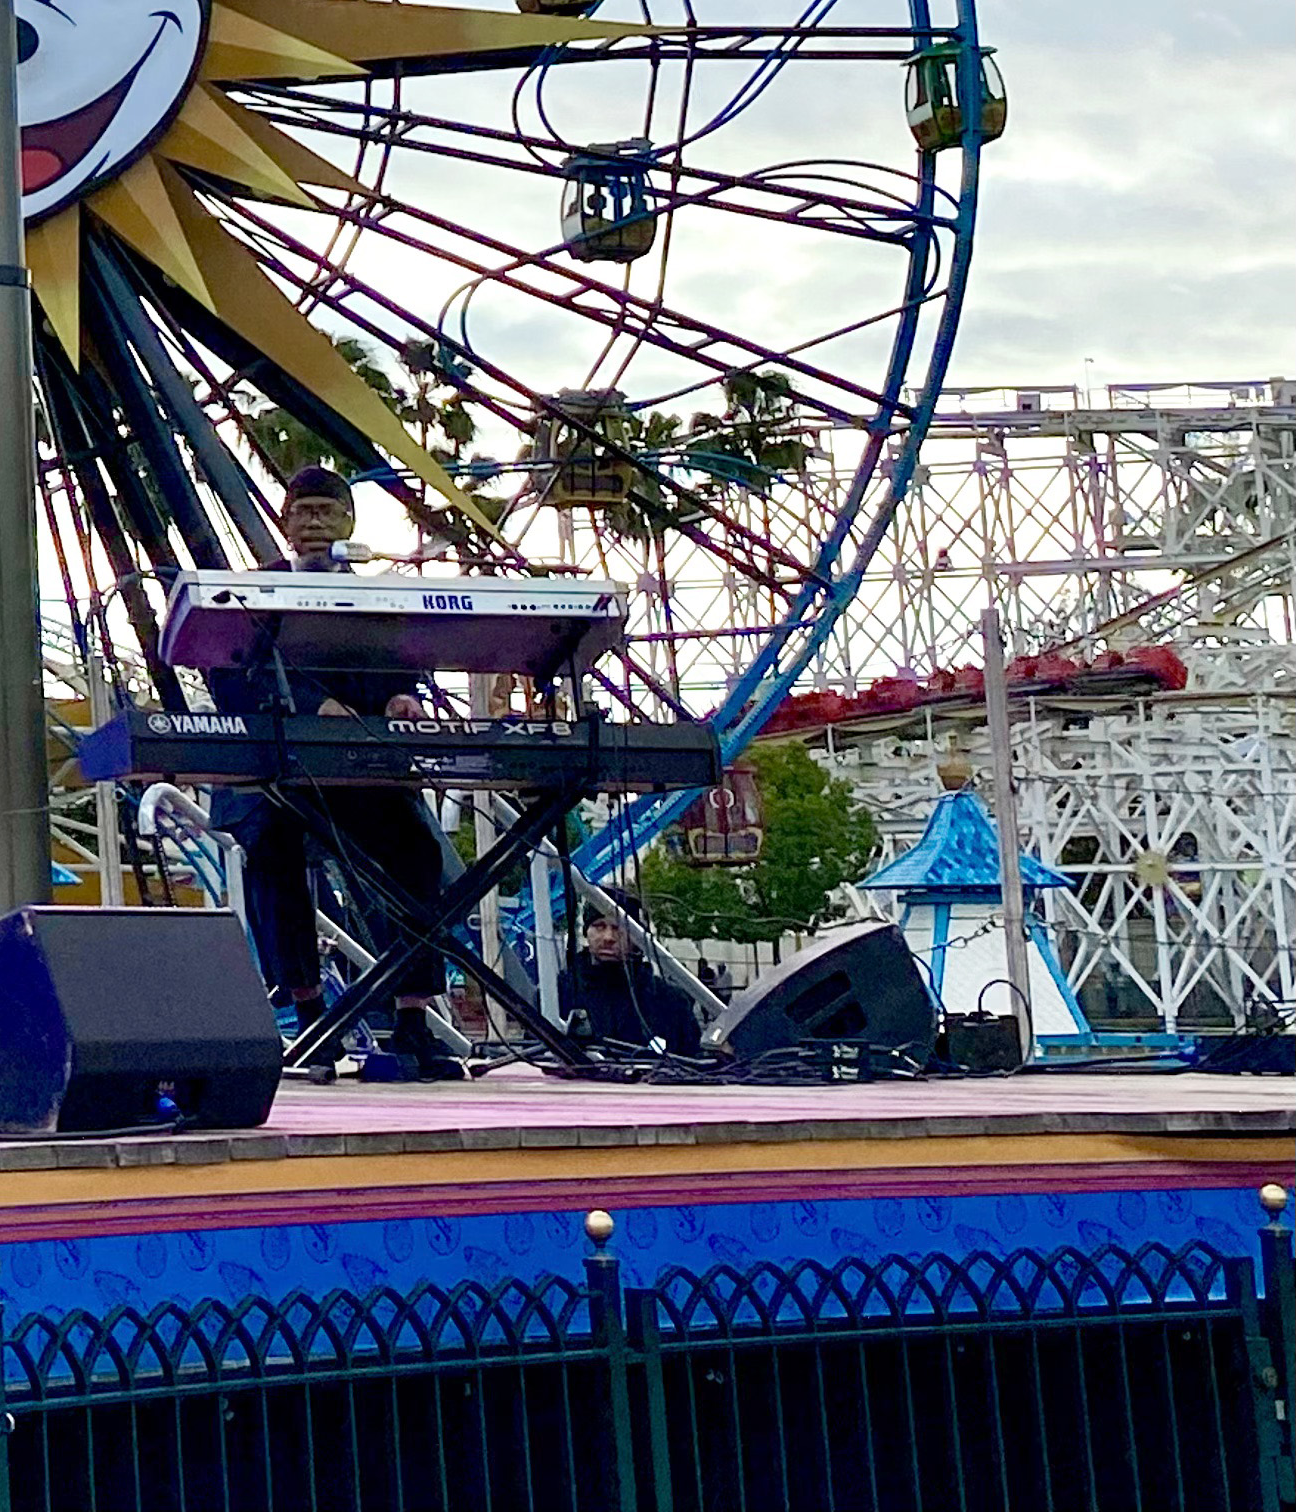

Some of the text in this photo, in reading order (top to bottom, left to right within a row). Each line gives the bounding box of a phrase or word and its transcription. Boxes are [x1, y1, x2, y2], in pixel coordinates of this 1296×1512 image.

[422, 594, 473, 611] KORG
[170, 714, 248, 734] YAMAHA
[388, 720, 492, 734] MOTIF
